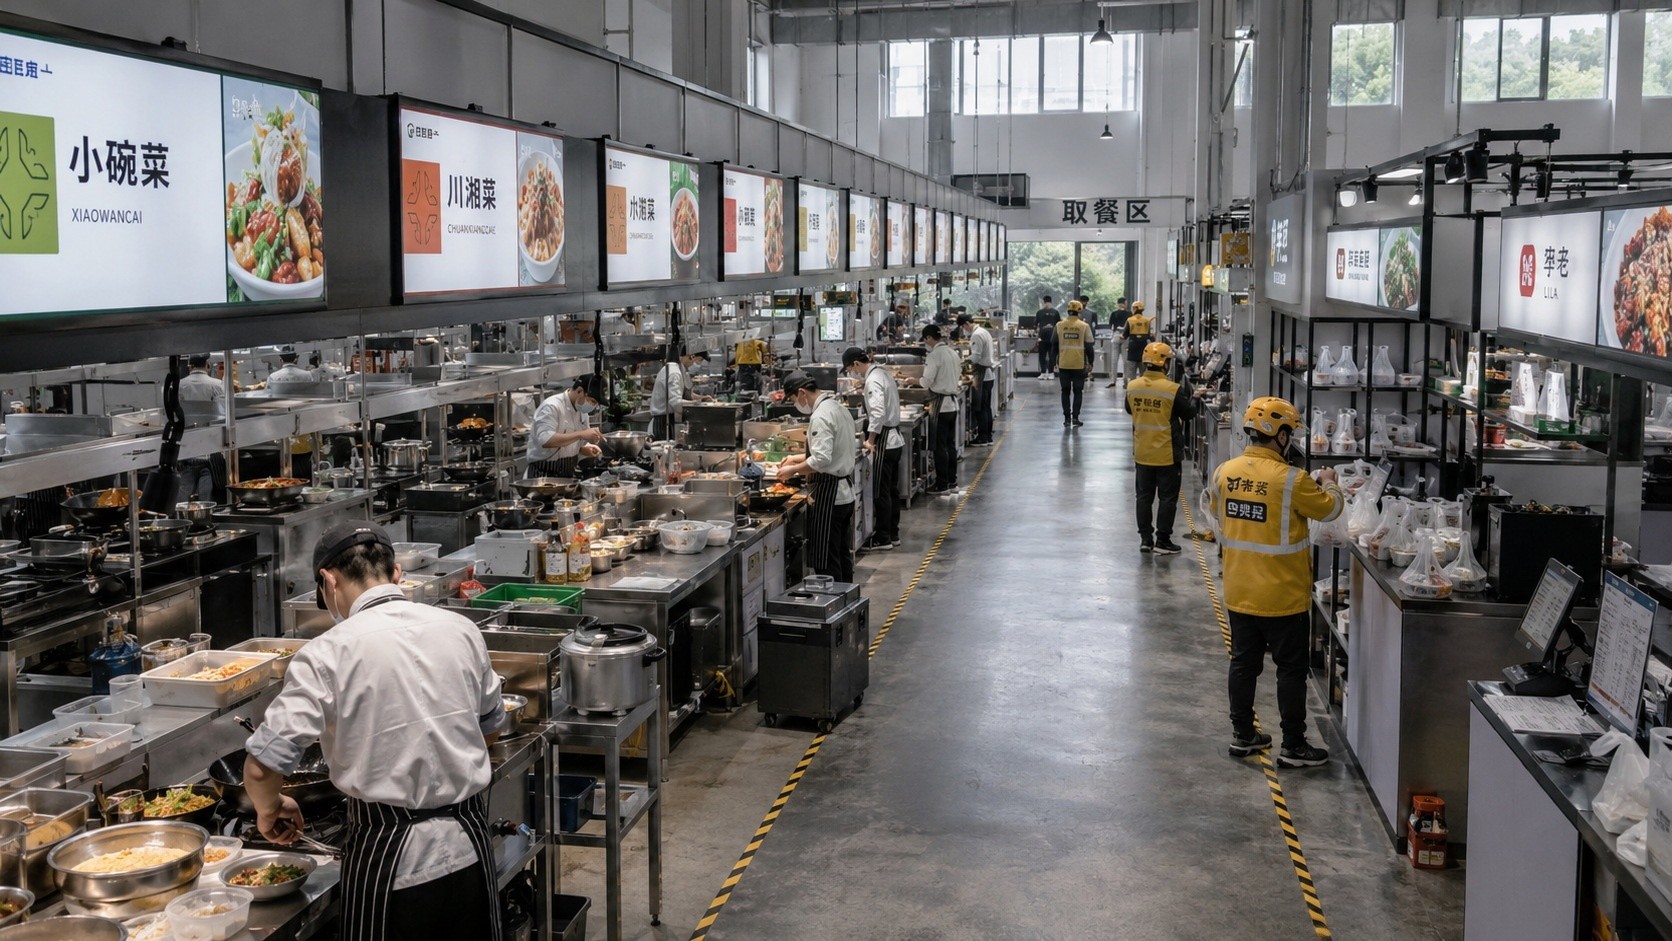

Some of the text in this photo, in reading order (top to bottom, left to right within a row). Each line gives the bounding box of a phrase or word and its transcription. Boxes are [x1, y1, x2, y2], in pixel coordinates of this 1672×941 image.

[69, 135, 170, 189] 小碗菜
[447, 174, 496, 210] 川湘菜
[71, 207, 143, 224] XIAOWANCAI
[1062, 199, 1150, 224] 取餐区
